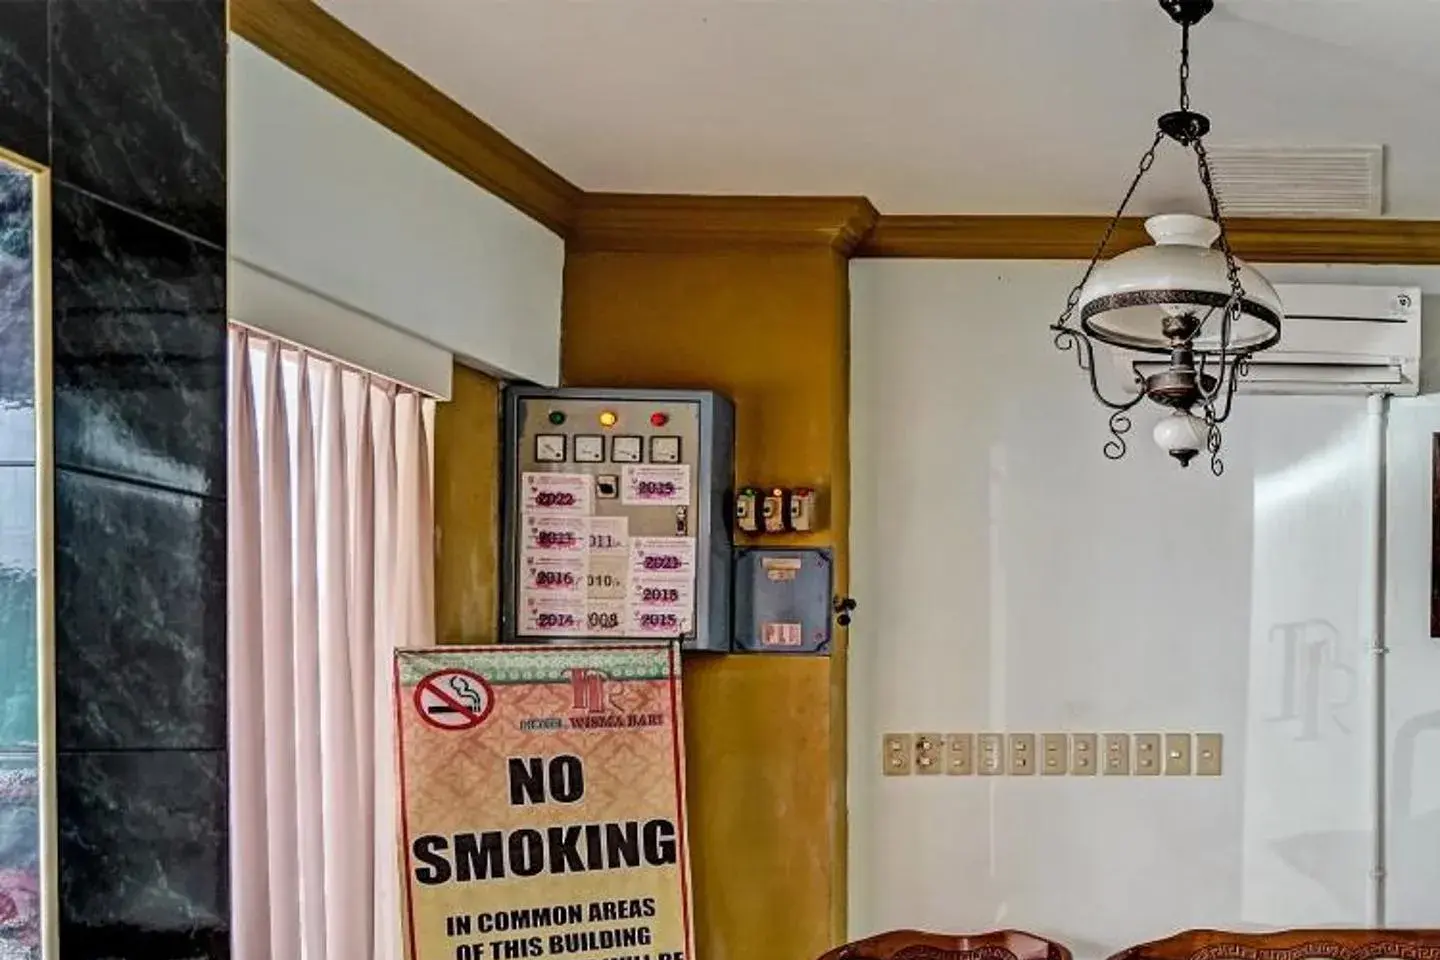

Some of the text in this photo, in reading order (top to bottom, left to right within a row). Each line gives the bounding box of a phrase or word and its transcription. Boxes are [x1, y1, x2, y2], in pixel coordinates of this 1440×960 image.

[570, 715, 623, 729] WISMA
[508, 754, 585, 805] NO
[412, 819, 677, 885] SMOKING
[446, 897, 655, 936] IN COMMON AREAS
[490, 936, 543, 960] THIS
[549, 926, 651, 955] BUILDING
